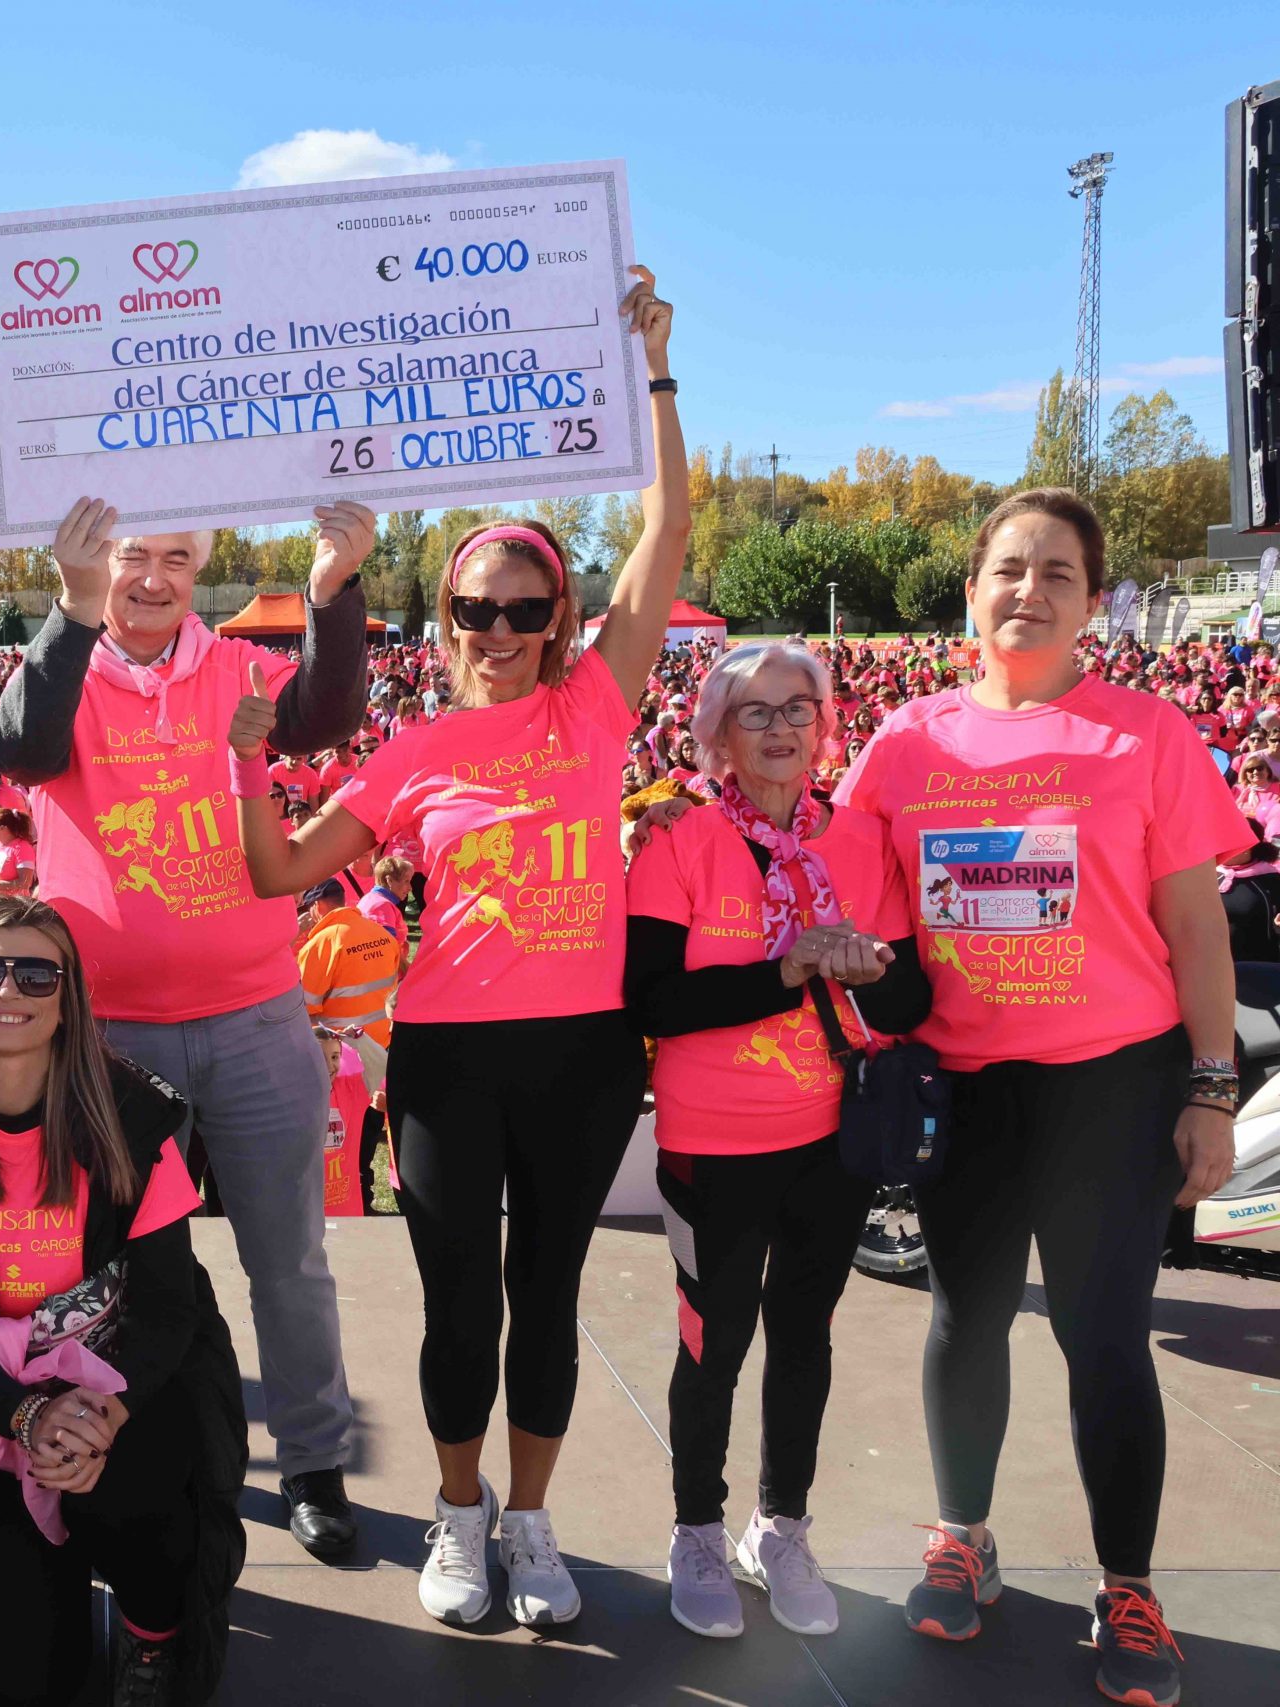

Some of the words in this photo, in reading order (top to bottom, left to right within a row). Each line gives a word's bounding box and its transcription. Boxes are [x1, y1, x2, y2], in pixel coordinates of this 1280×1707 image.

[554, 200, 589, 214] 1000
[414, 239, 529, 283] 40.000
[537, 249, 588, 265] EUROS
[119, 286, 221, 314] almom
[0, 303, 102, 330] almom
[111, 331, 221, 367] Centro
[234, 323, 276, 354] de
[289, 303, 512, 350] Investigación
[12, 362, 76, 377] DONACIÓN:
[114, 375, 165, 409] del
[176, 370, 292, 403] Cáncer
[304, 360, 346, 392] de
[357, 348, 540, 385] Salamanca
[97, 391, 340, 451] CUARENTA
[366, 384, 446, 426] MIL
[464, 371, 587, 417] EUROS
[18, 443, 56, 455] EUROS
[329, 437, 375, 475] 26
[401, 421, 542, 470] OCTUBRE
[925, 762, 1069, 793] Drasanvi
[1008, 793, 1092, 807] CAROBELS
[931, 839, 950, 858] hp
[1028, 846, 1066, 856] almom
[163, 846, 242, 878] Carrera
[189, 864, 243, 894] Mujer
[960, 866, 1075, 886] MADRINA
[191, 889, 229, 906] almom
[516, 882, 606, 908] Carrera
[987, 896, 1036, 907] Carrera
[180, 895, 251, 920] DRASANVI
[543, 902, 606, 928] Mujer
[539, 929, 581, 940] almom
[967, 933, 1086, 956] Carrera
[363, 950, 384, 961] CIVIL
[525, 939, 605, 954] DRASANVI
[968, 960, 984, 970] de
[986, 961, 998, 971] la
[999, 955, 1086, 981] Mujer
[996, 980, 1051, 992] almom
[983, 993, 1087, 1005] DRASANVI
[1227, 1203, 1277, 1219] SUZUKI
